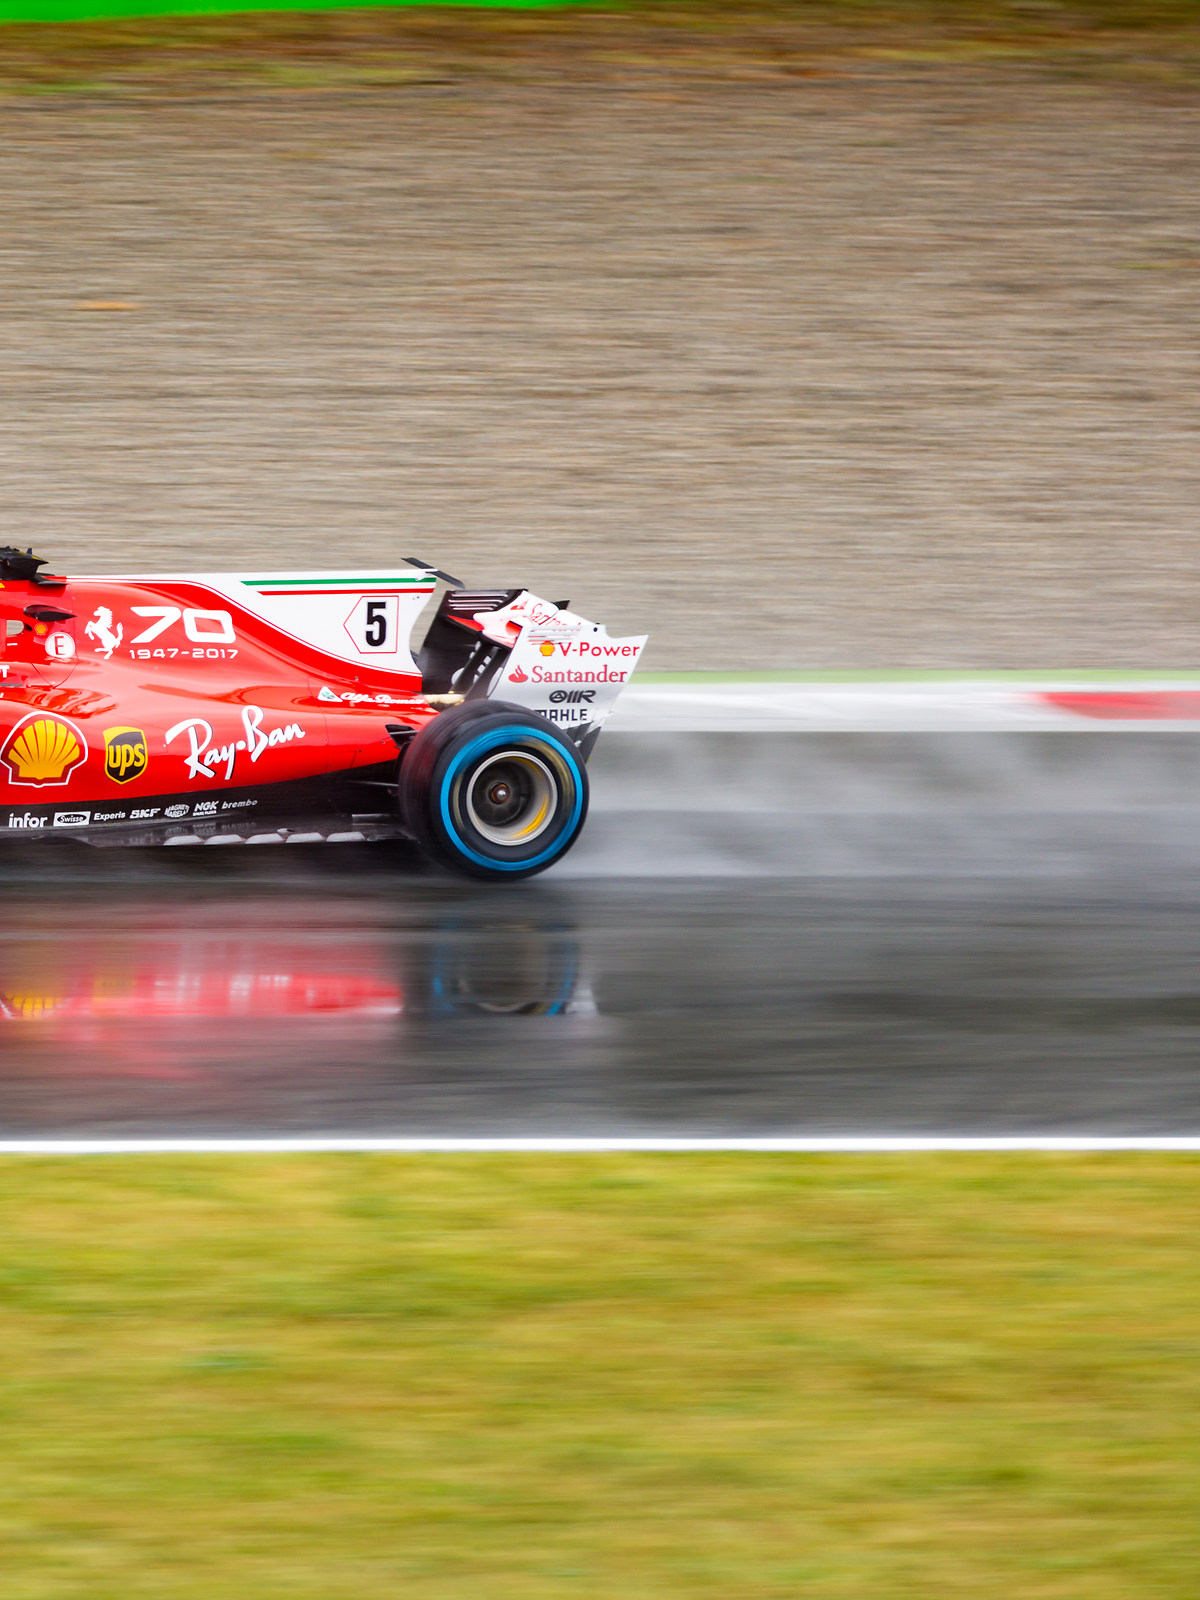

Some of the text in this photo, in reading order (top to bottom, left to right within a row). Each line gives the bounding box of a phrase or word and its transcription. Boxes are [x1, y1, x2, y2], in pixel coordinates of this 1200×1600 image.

[130, 606, 236, 643] 70
[365, 601, 387, 647] 5
[54, 635, 67, 655] E
[559, 642, 640, 656] V-Power
[129, 648, 238, 659] 1947-2017
[532, 665, 627, 683] Santander
[108, 743, 145, 776] ups
[194, 801, 219, 812] NGK
[221, 799, 259, 810] brembo
[8, 812, 49, 828] infor
[60, 814, 85, 824] Swisse
[93, 811, 127, 821] Experis
[130, 808, 161, 819] SKF
